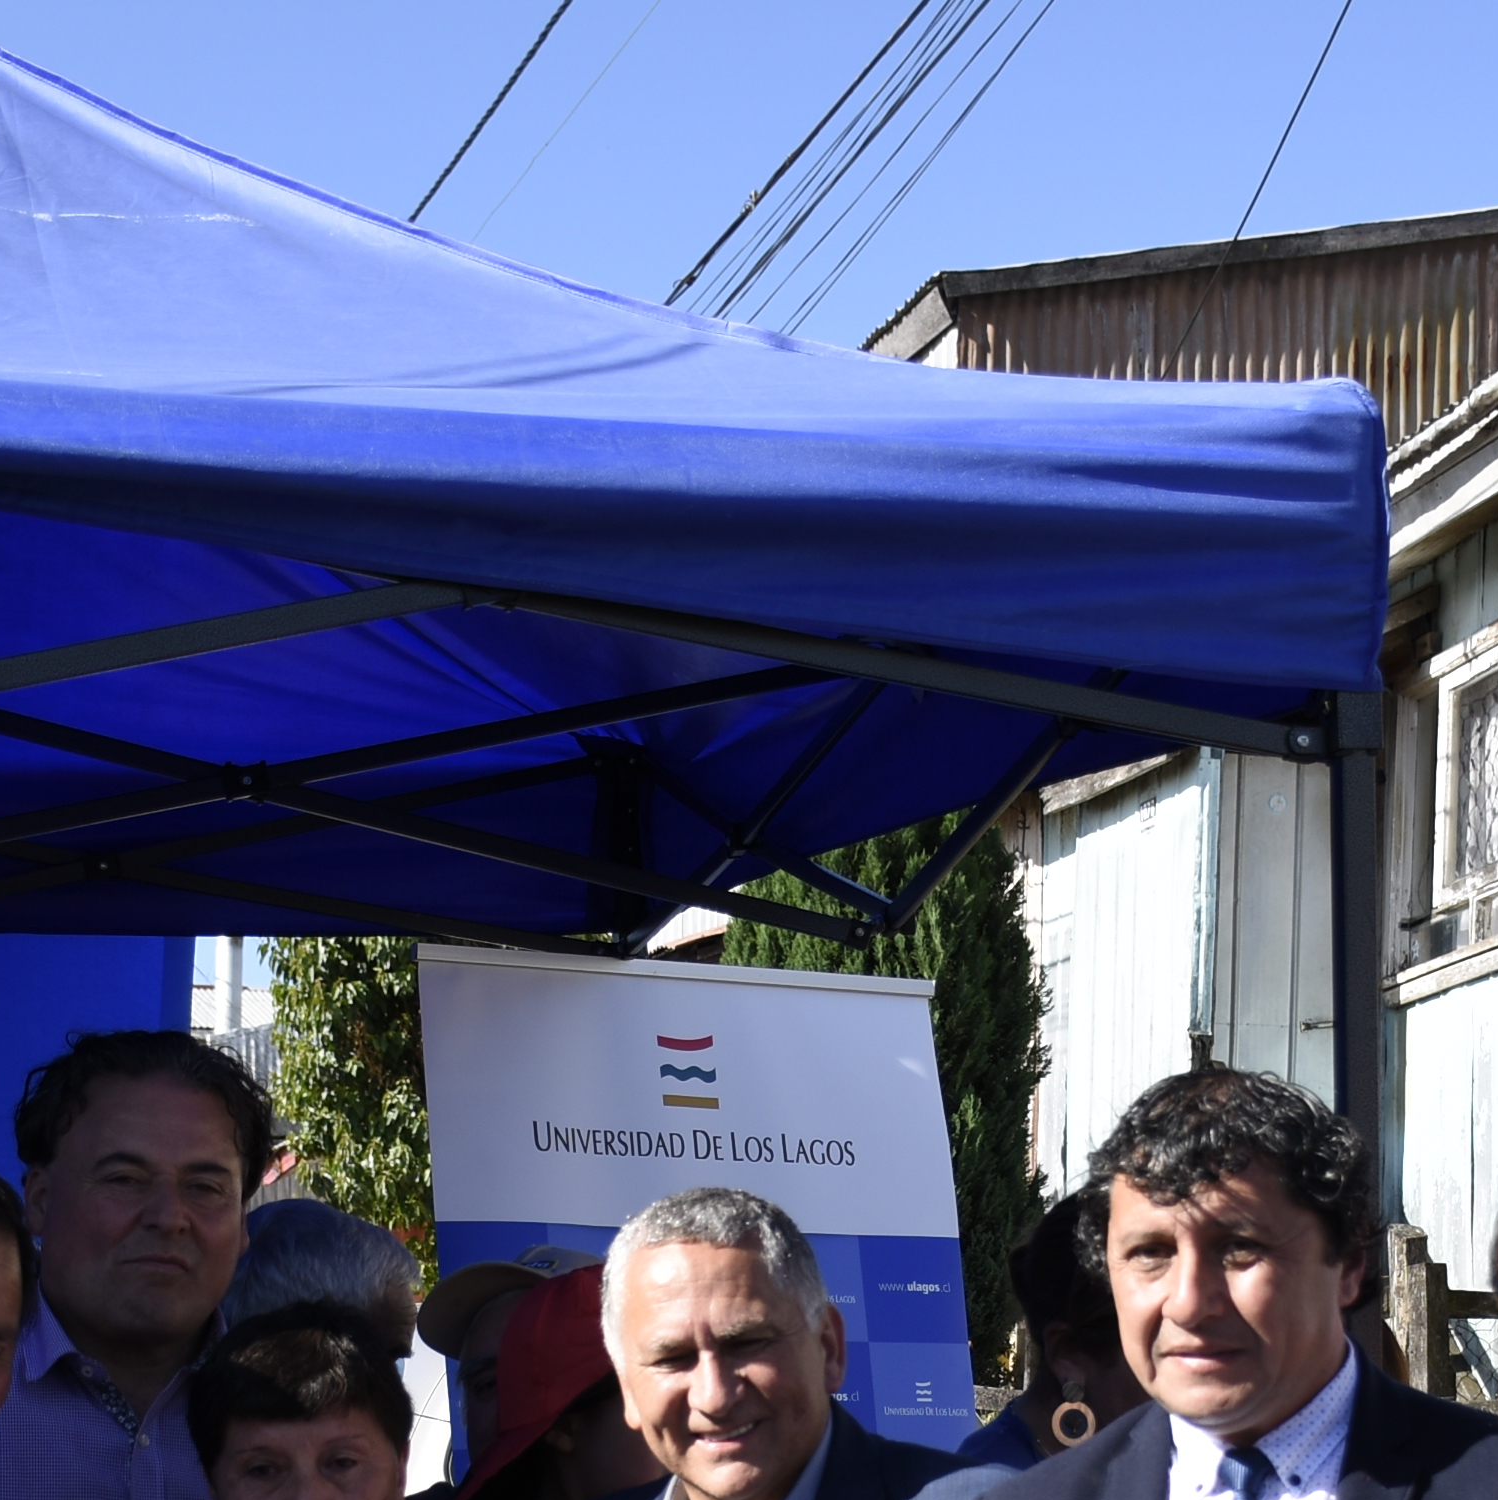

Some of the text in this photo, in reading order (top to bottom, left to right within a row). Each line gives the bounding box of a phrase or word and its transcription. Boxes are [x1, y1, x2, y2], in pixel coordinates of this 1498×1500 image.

[532, 1120, 857, 1167] UNIVERSIDAD DE LOS LAGOS
[878, 1280, 951, 1295] www.ulagos.cl
[835, 1295, 856, 1304] LAGOS
[884, 1406, 968, 1417] UNIVERSIDAD DE LOS LAGOS
